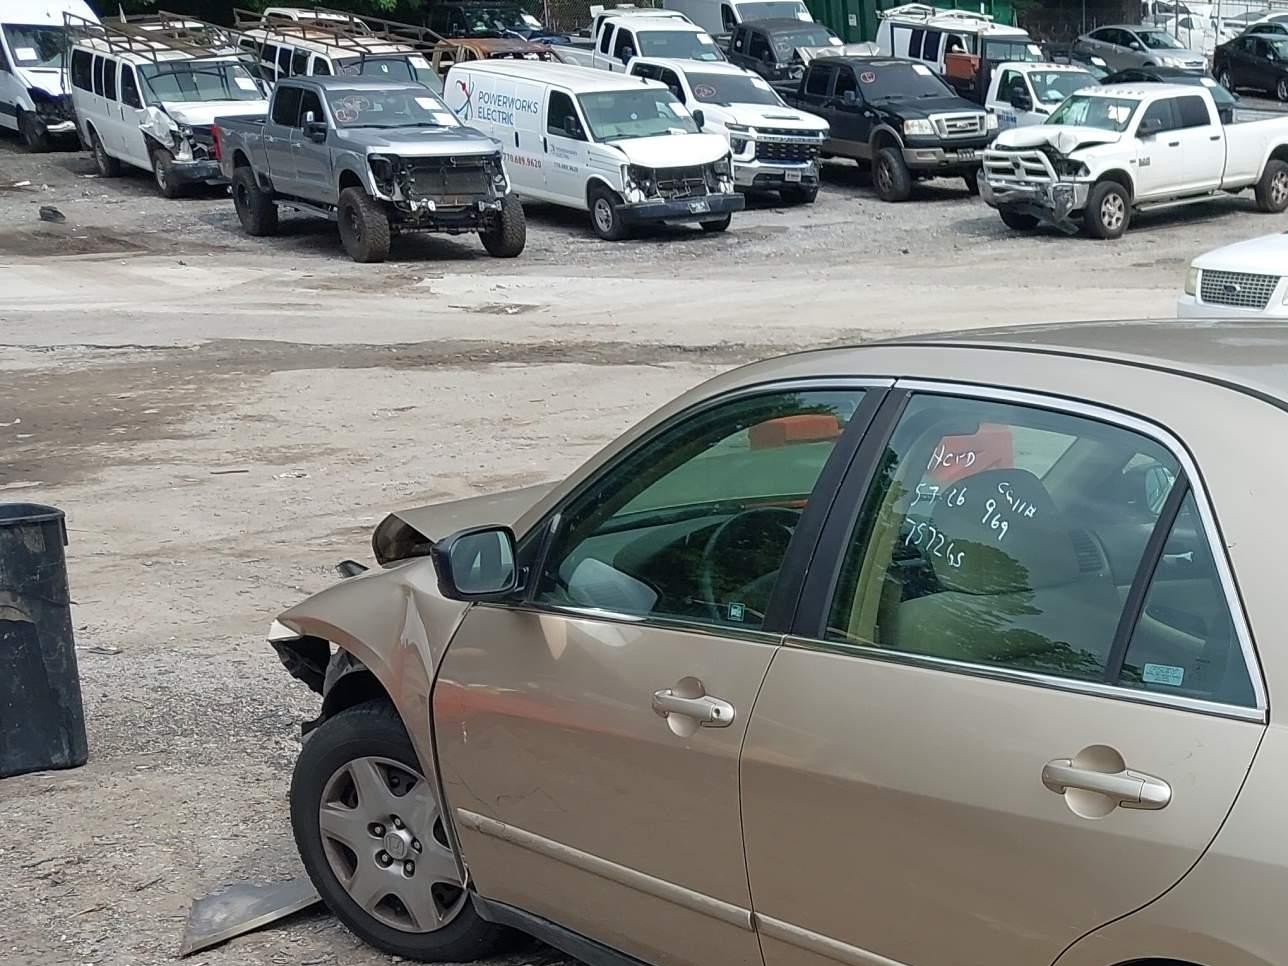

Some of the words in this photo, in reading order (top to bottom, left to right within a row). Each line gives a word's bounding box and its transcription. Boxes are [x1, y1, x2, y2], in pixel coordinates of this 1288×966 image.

[478, 90, 539, 114] POWERWORKS
[477, 106, 514, 126] ELECTRIC
[981, 499, 1009, 541] 969
